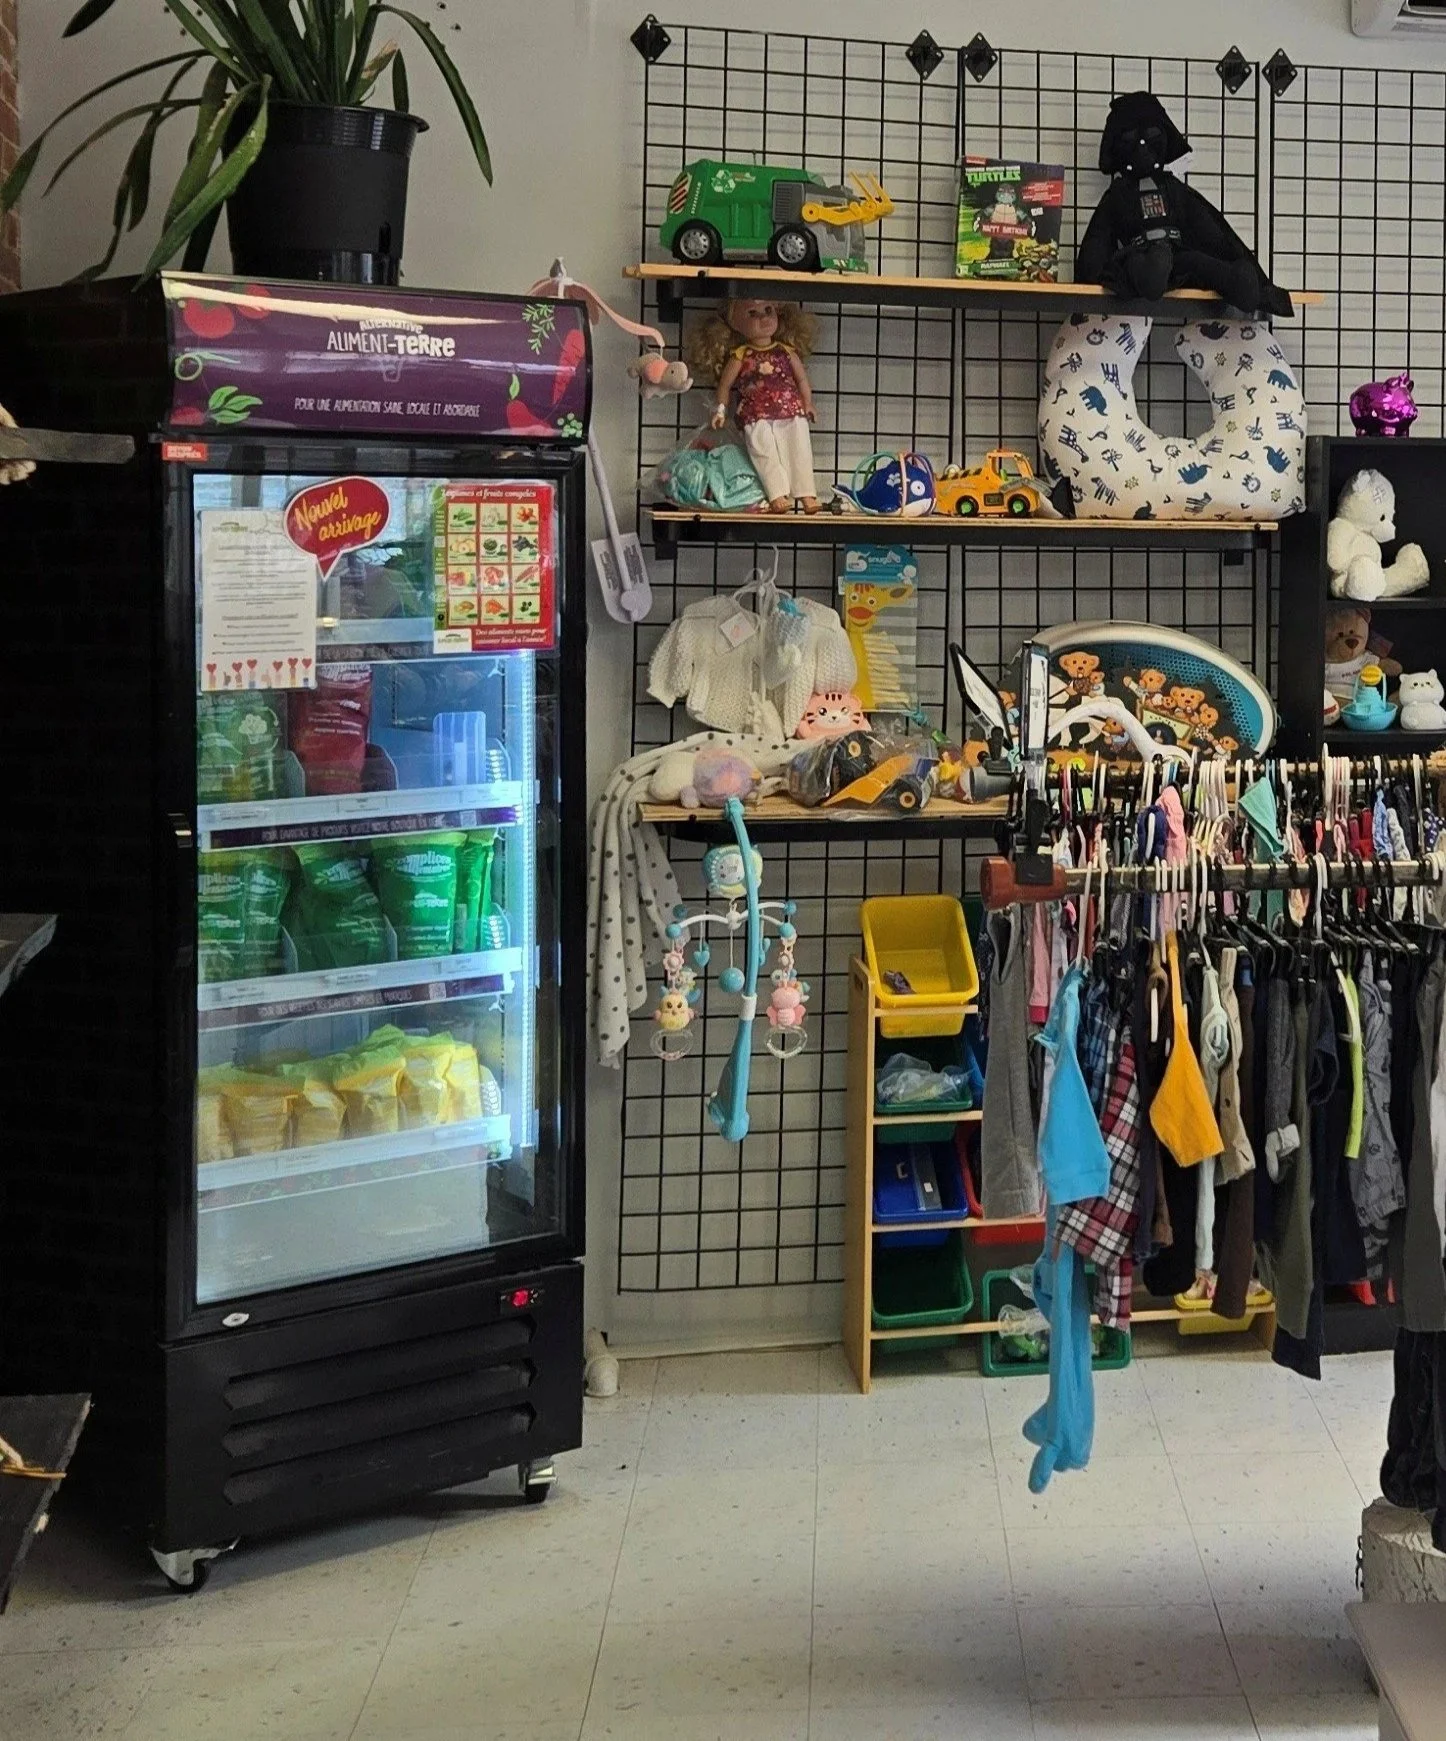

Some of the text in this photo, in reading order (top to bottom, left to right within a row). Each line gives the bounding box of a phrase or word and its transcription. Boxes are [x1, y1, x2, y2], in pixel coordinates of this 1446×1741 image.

[294, 397, 315, 411] POUR
[316, 398, 331, 412] UNE
[333, 399, 382, 413] ALIMENTATION
[406, 402, 431, 416] LOCALE
[432, 402, 442, 416] ET
[442, 403, 481, 418] ABORDABLE
[294, 486, 349, 532] Nouvel
[318, 511, 382, 541] arrivage
